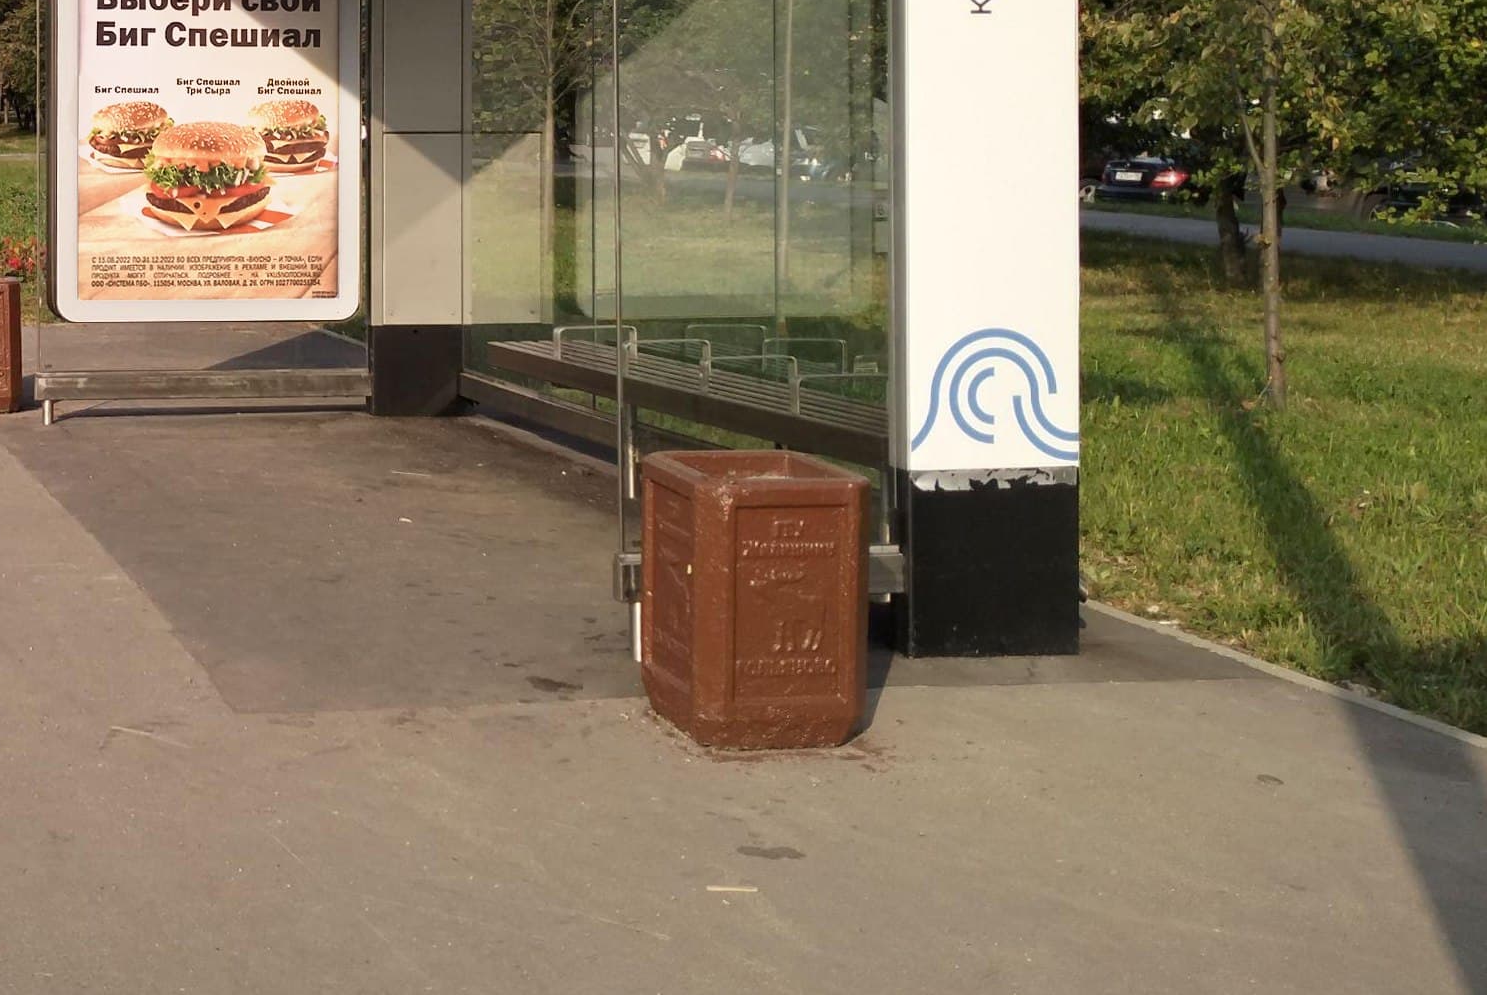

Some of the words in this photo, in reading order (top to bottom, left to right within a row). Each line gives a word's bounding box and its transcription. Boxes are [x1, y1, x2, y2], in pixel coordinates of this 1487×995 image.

[96, 21, 156, 47] Биг
[164, 21, 321, 48] Спешиал
[176, 78, 194, 86] Биг
[196, 78, 240, 86] Спешиал
[267, 77, 310, 87] Двойной
[94, 86, 112, 94] Биг
[114, 86, 159, 94] Спешиал
[186, 87, 202, 96] Три
[204, 87, 231, 96] Сыра
[257, 87, 275, 95] Биг
[277, 87, 322, 95] Спешиал
